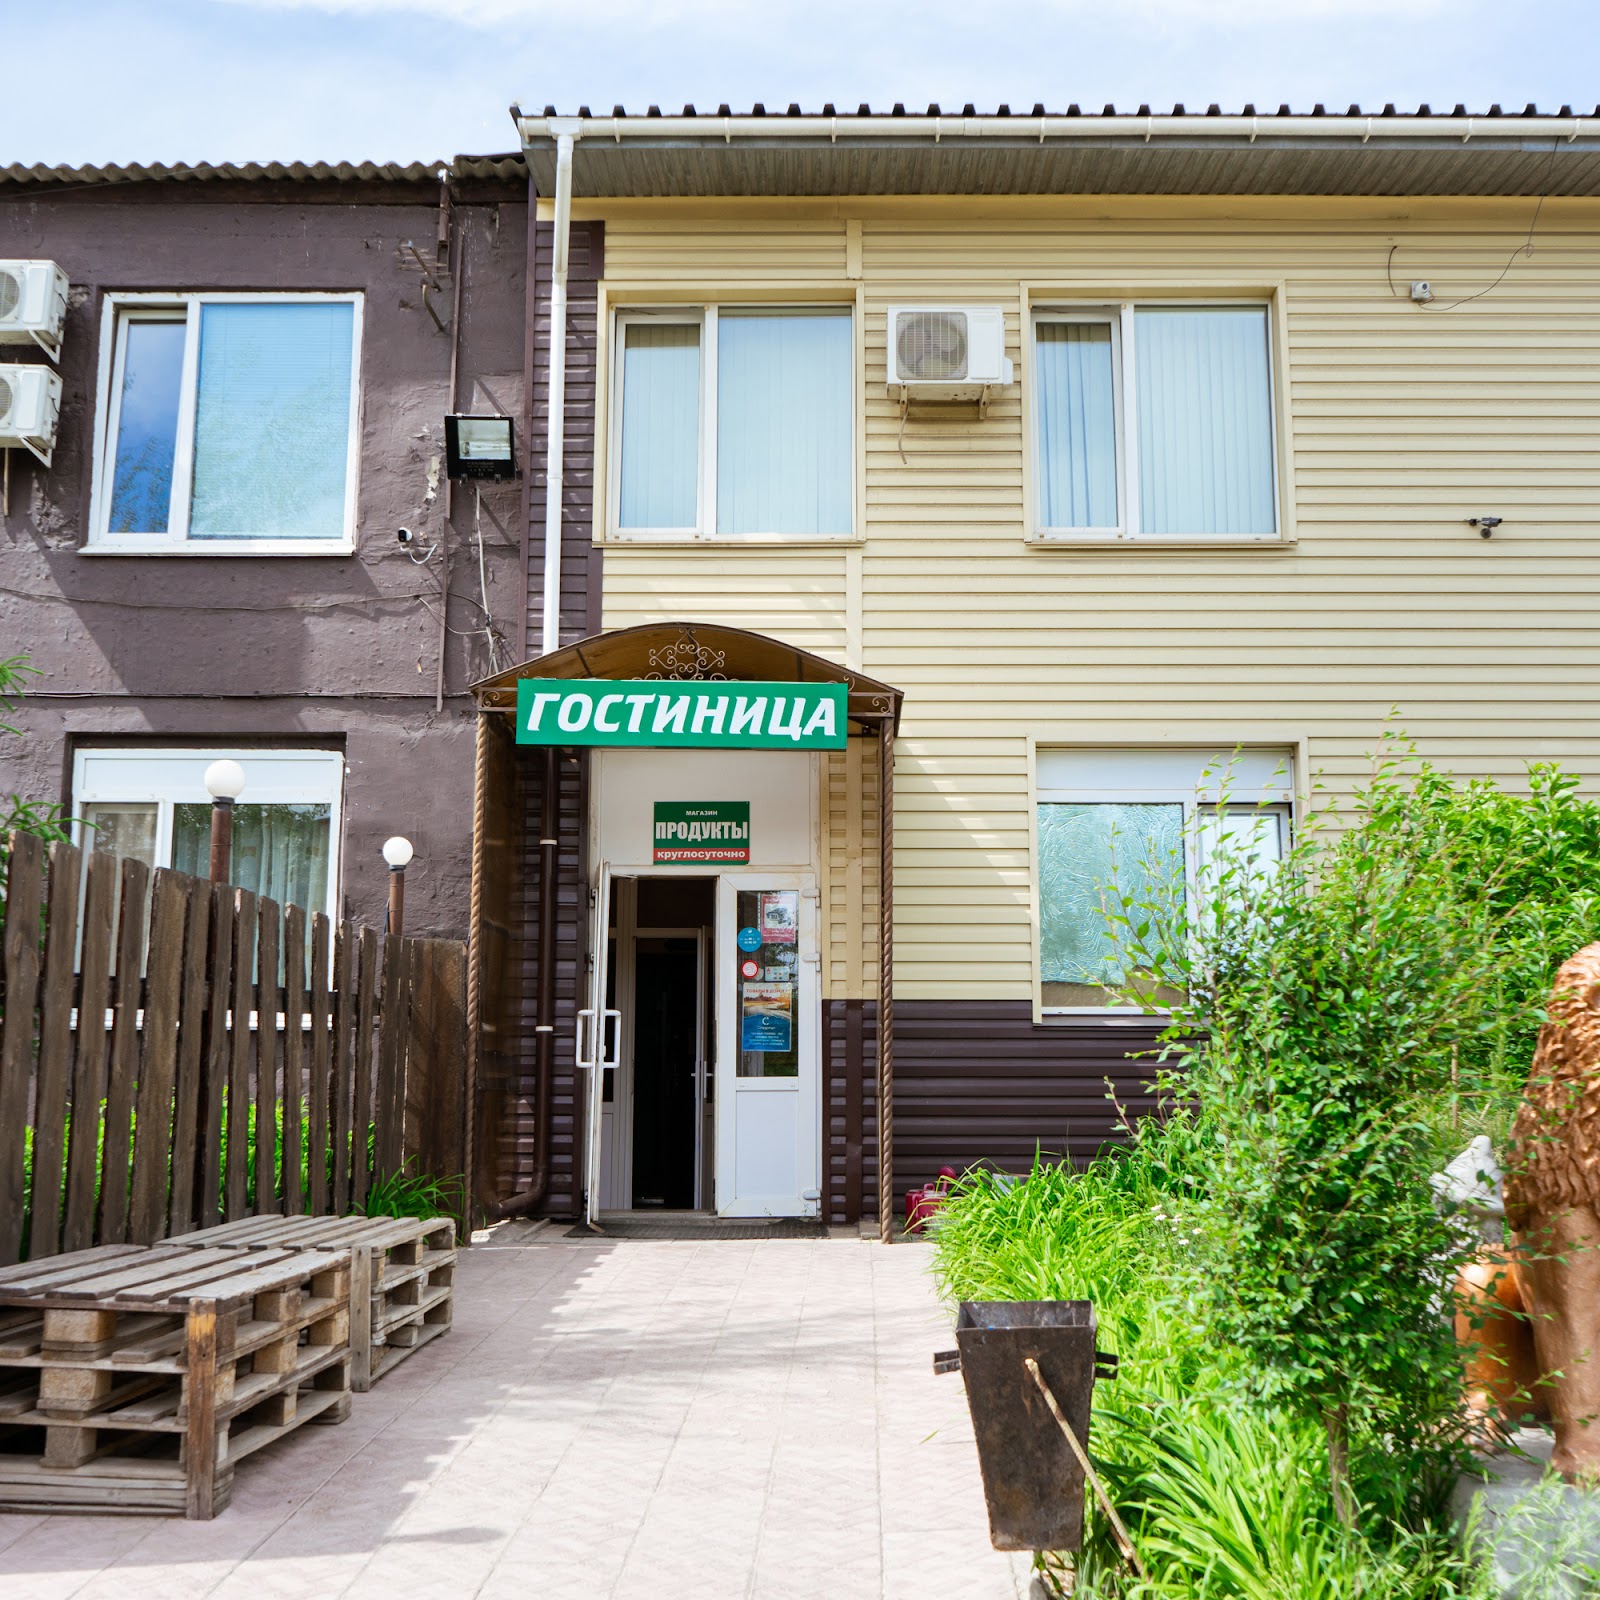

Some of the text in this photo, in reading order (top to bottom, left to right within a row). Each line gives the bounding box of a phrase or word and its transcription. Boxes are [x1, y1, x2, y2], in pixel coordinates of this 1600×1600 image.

[526, 692, 838, 741] ГОСТИНИЦА
[655, 821, 748, 842] ПРОДУКТЫ
[657, 851, 746, 860] круглосуточно
